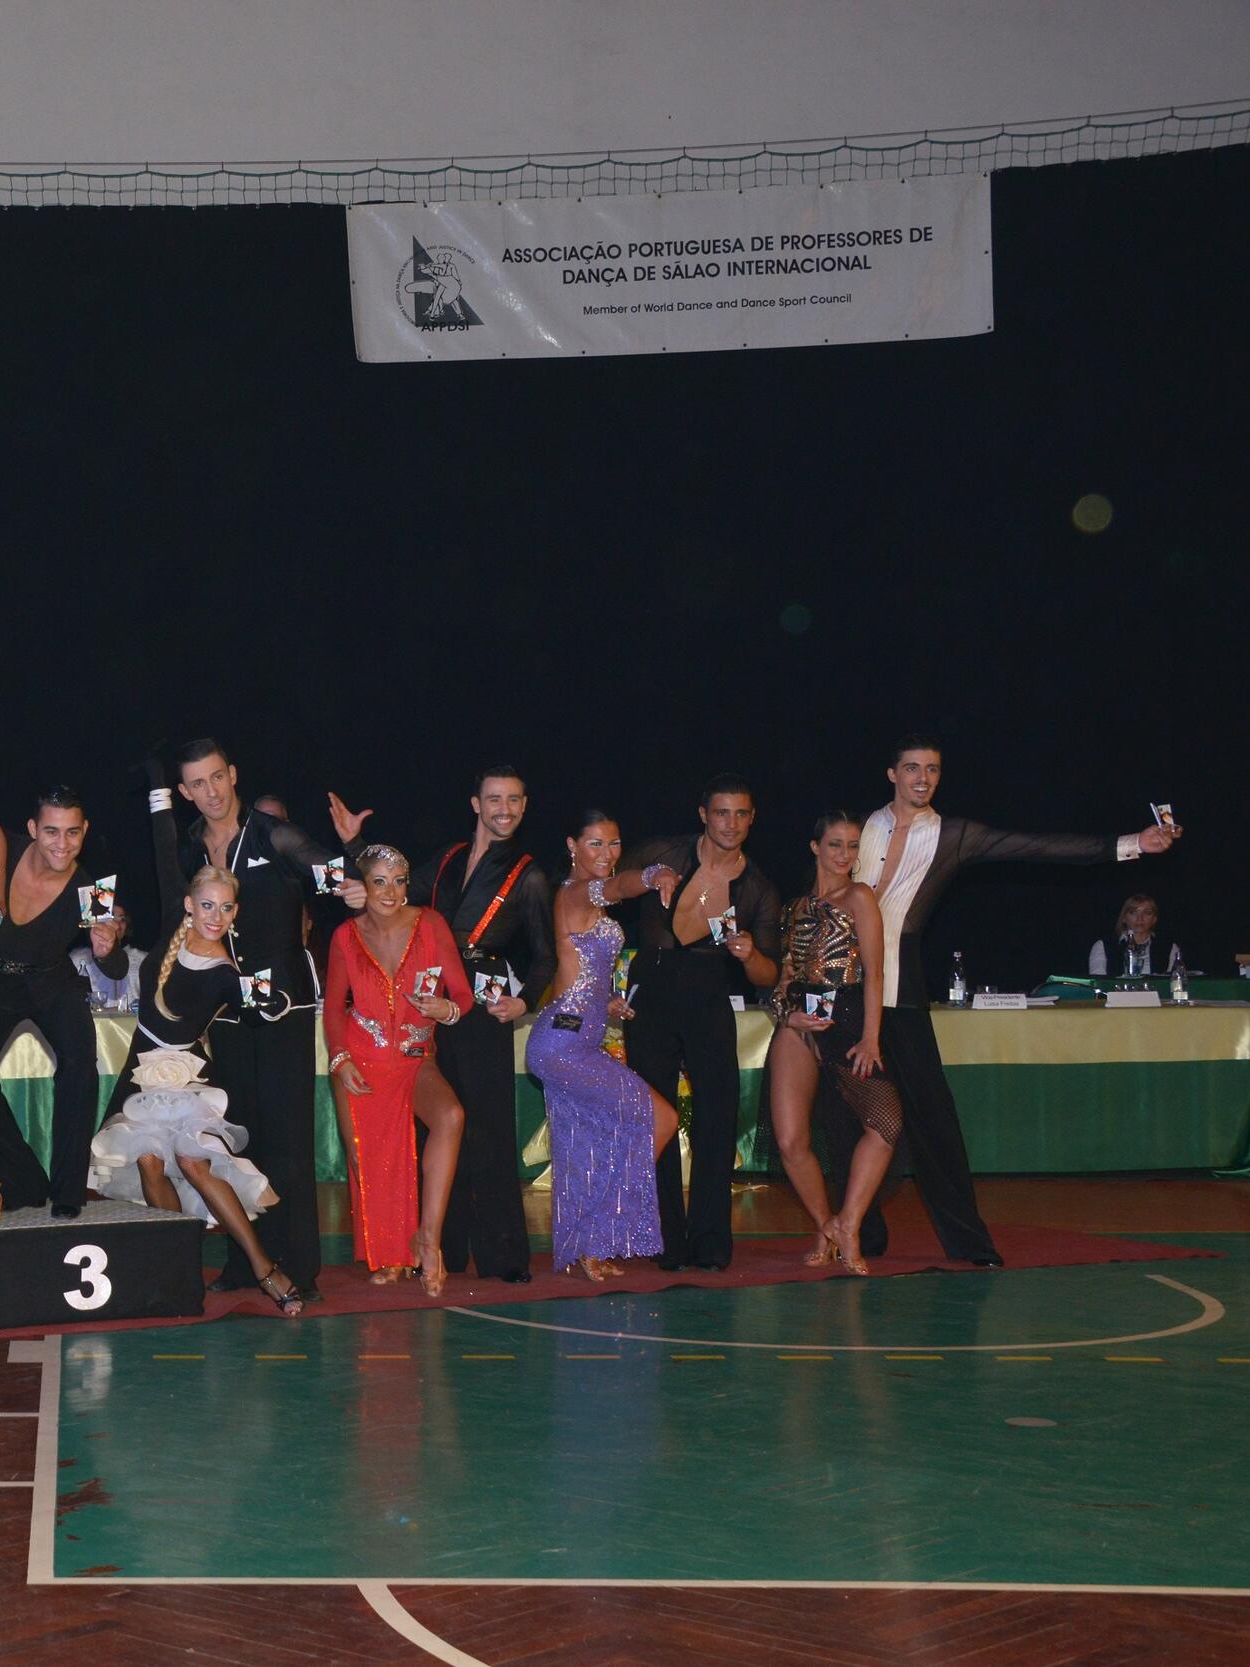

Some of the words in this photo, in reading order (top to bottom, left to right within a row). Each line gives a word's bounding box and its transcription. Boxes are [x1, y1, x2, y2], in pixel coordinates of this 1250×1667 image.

[501, 240, 622, 265] ASSOCIAÇÃO
[628, 237, 745, 259] PORTUGUESA
[751, 235, 774, 251] DE
[780, 229, 903, 251] PROFESSORES
[910, 226, 933, 243] DE
[562, 266, 628, 288] DANÇA
[633, 265, 656, 282] DE
[727, 254, 872, 277] INTERNACIONAL
[583, 304, 628, 316] Member
[630, 303, 642, 314] of
[644, 301, 674, 313] World
[677, 300, 713, 312] Dance
[715, 299, 738, 310] and
[741, 297, 776, 308] Dance
[778, 295, 807, 308] Sport
[809, 293, 852, 305] Council
[421, 320, 470, 332] APPDSI
[62, 1244, 113, 1312] 3
